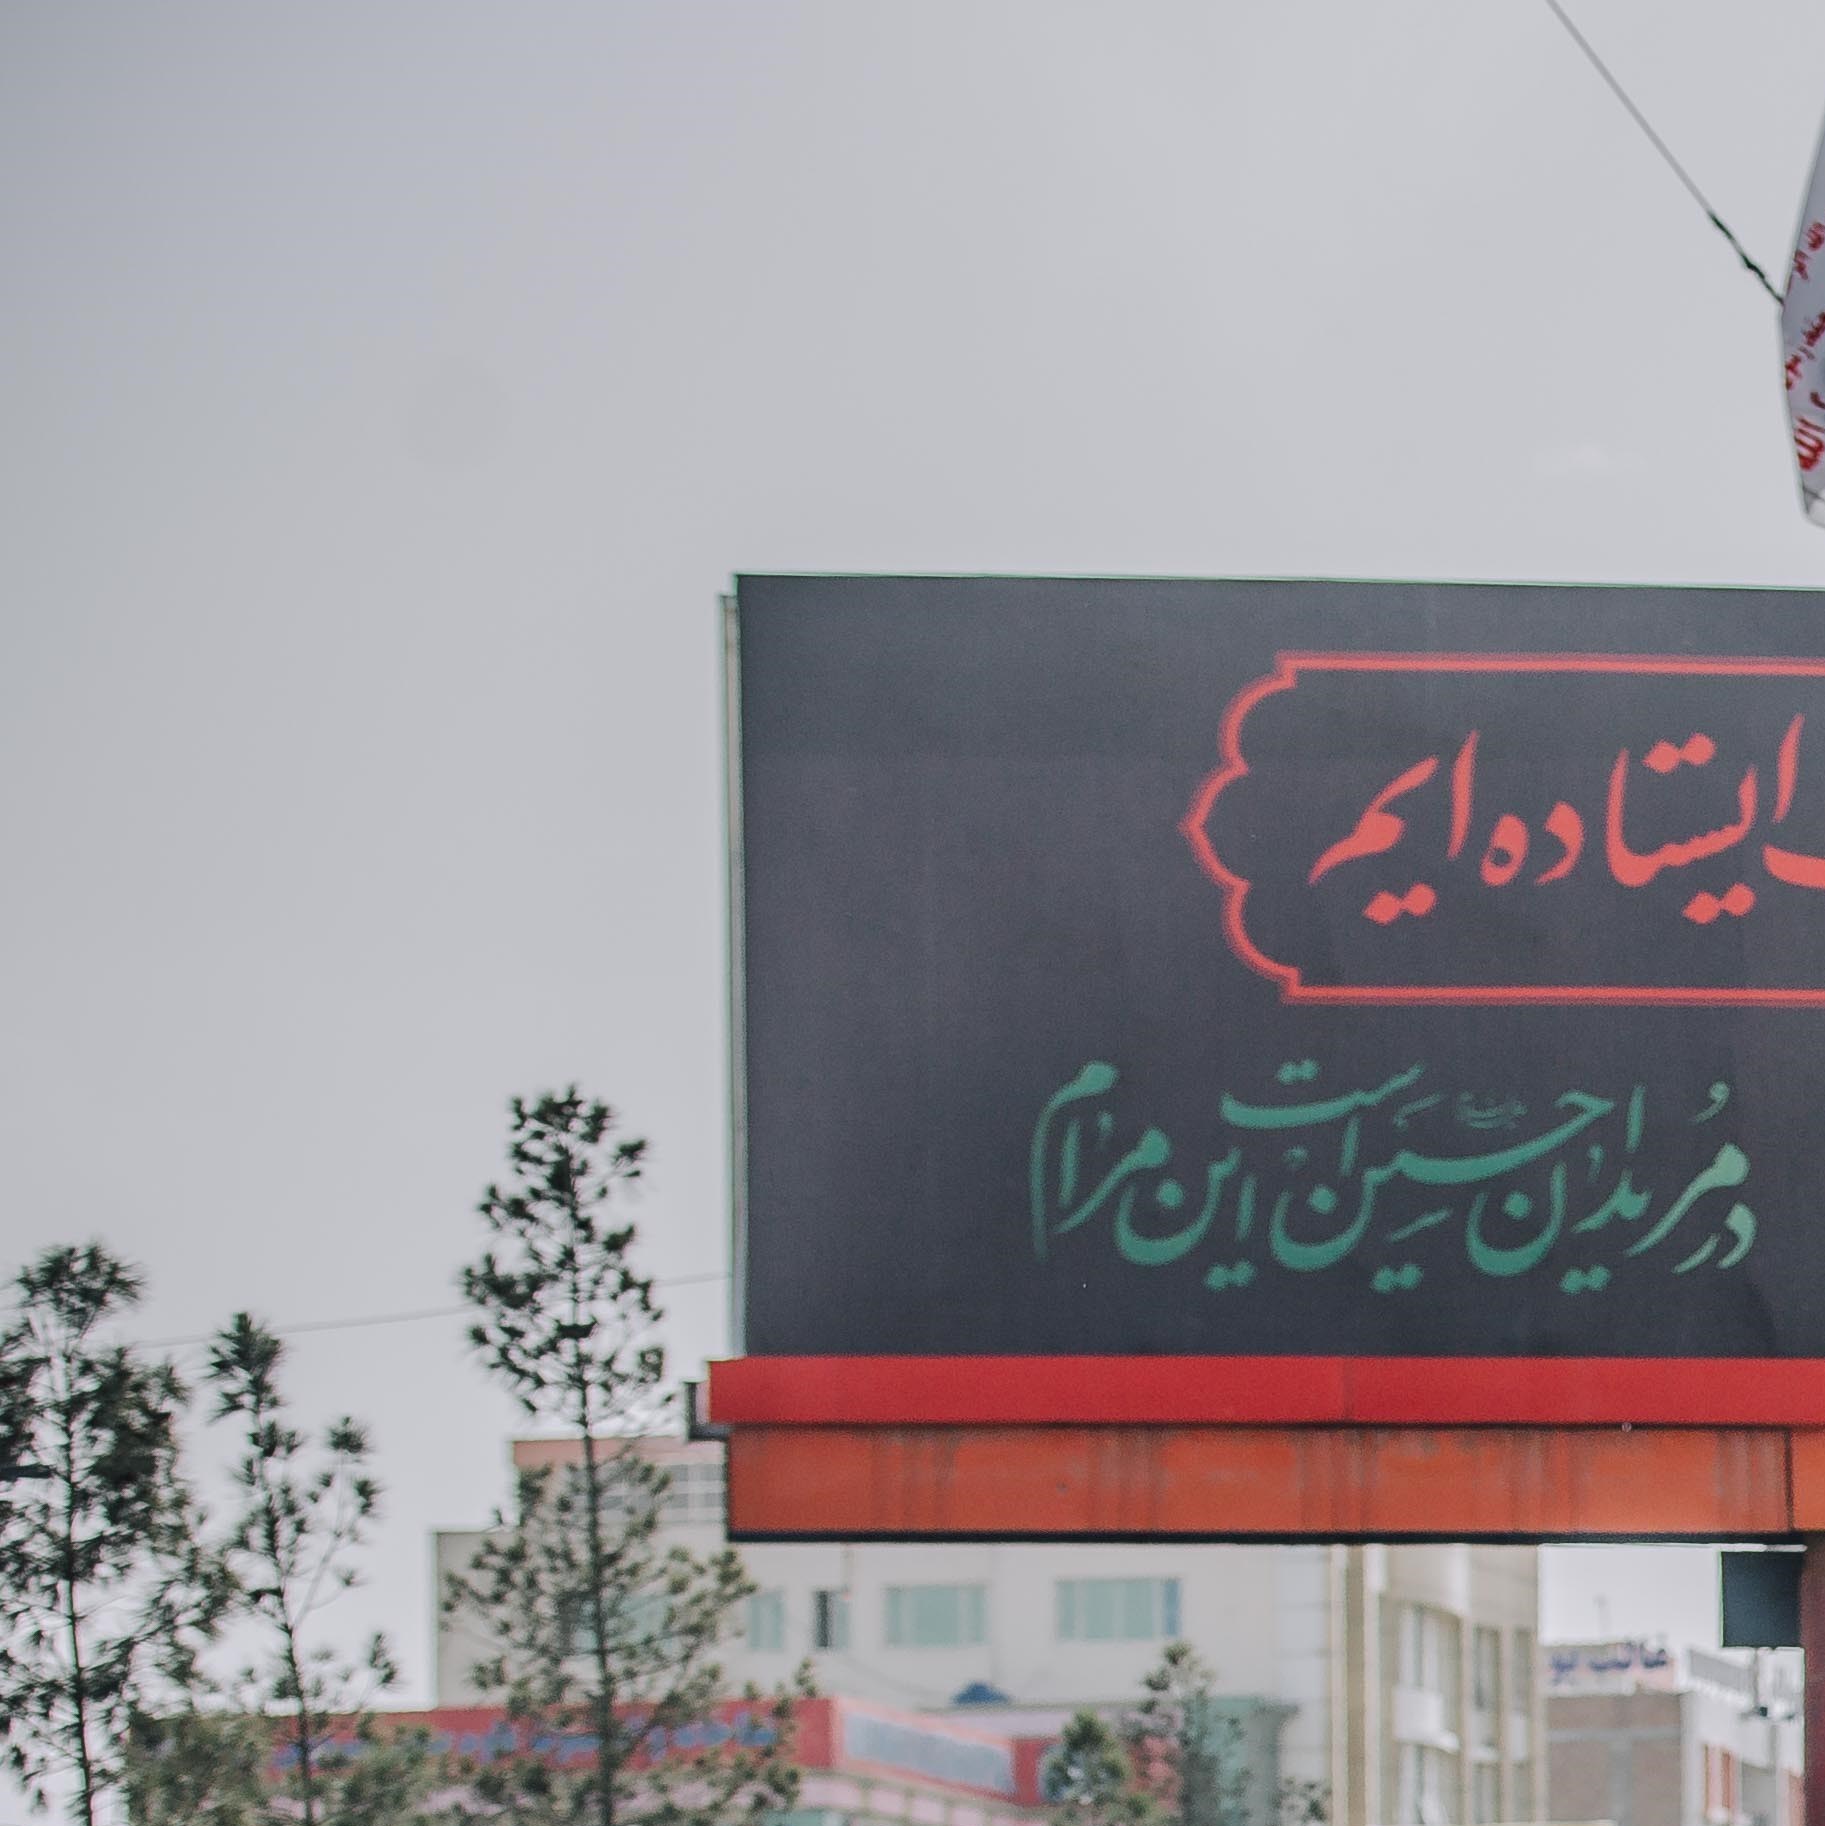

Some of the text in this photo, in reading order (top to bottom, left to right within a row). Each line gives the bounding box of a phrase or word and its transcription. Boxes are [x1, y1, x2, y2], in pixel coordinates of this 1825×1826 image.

[1308, 731, 1482, 925] ایم
[1474, 713, 1804, 926] ایستاده
[1673, 1203, 1757, 1274] در
